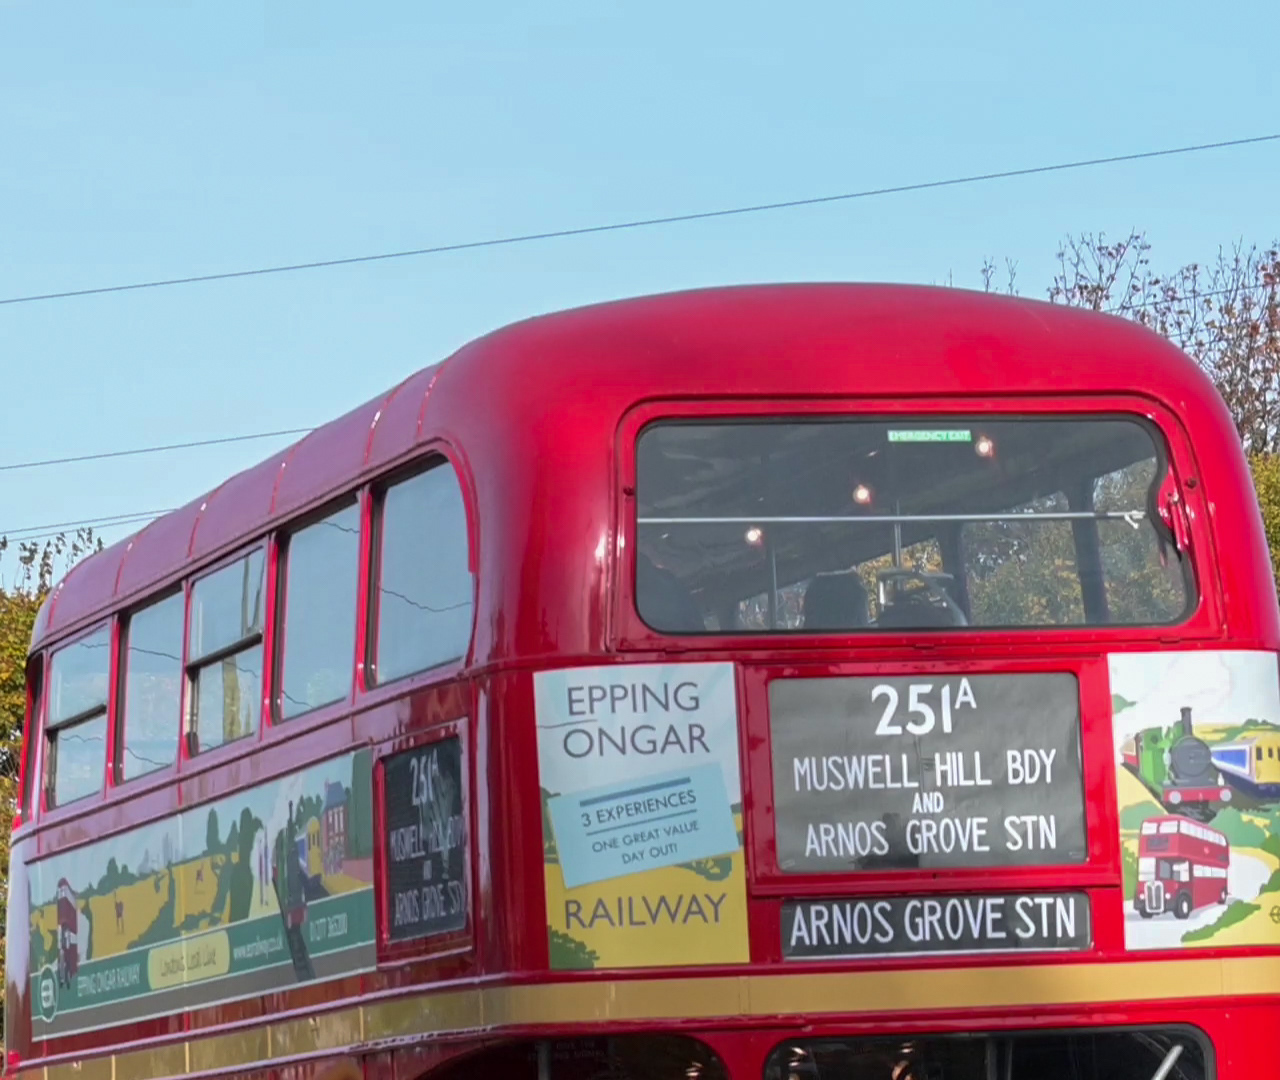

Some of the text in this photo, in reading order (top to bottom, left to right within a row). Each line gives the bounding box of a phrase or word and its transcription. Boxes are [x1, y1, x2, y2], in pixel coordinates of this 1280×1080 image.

[567, 681, 700, 716] EPPING
[563, 724, 710, 758] ONGAR
[793, 749, 1056, 791] MUSWELL HILL BDY
[581, 790, 697, 827] 3 EXPERIENCES
[912, 792, 944, 814] AND
[592, 820, 699, 853] ONE GREAT VALUE
[622, 843, 678, 864] DAY OUT!
[805, 815, 1057, 857] ARNOS GROVE STN
[565, 893, 727, 930] RAILWAY
[790, 897, 1076, 946] ARNOS GROVE STN
